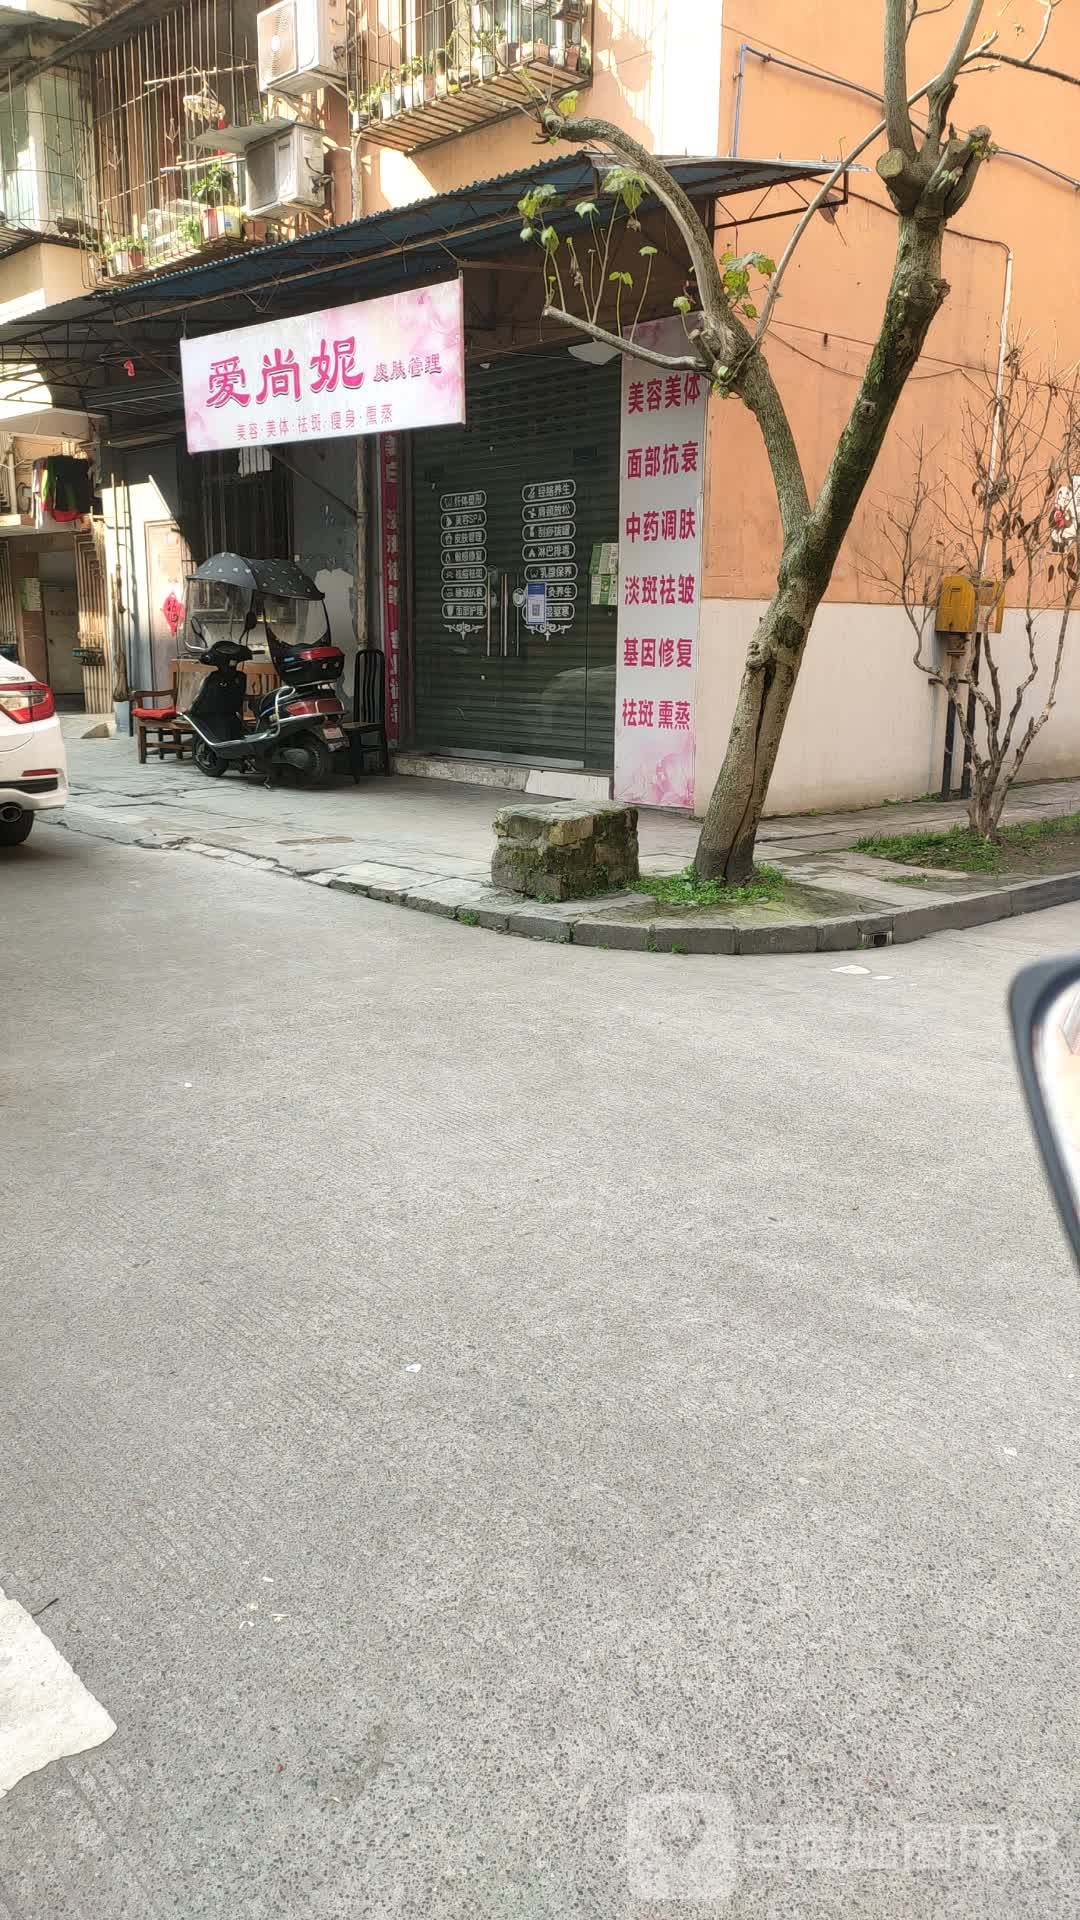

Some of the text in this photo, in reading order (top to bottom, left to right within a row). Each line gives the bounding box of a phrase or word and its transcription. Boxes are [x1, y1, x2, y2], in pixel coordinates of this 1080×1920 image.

[206, 336, 443, 408] 爱尚妮 皮肤管理
[628, 372, 700, 414] 美容美体
[627, 440, 699, 480] 面部抗衰
[454, 531, 482, 544] 皮肤管理
[625, 507, 696, 544] 中药调肤
[537, 545, 570, 558] 淋巴排毒
[624, 573, 695, 605] 淡斑祛皱
[624, 637, 693, 668] 基因修复
[622, 698, 691, 730] 祛斑 熏蒸
